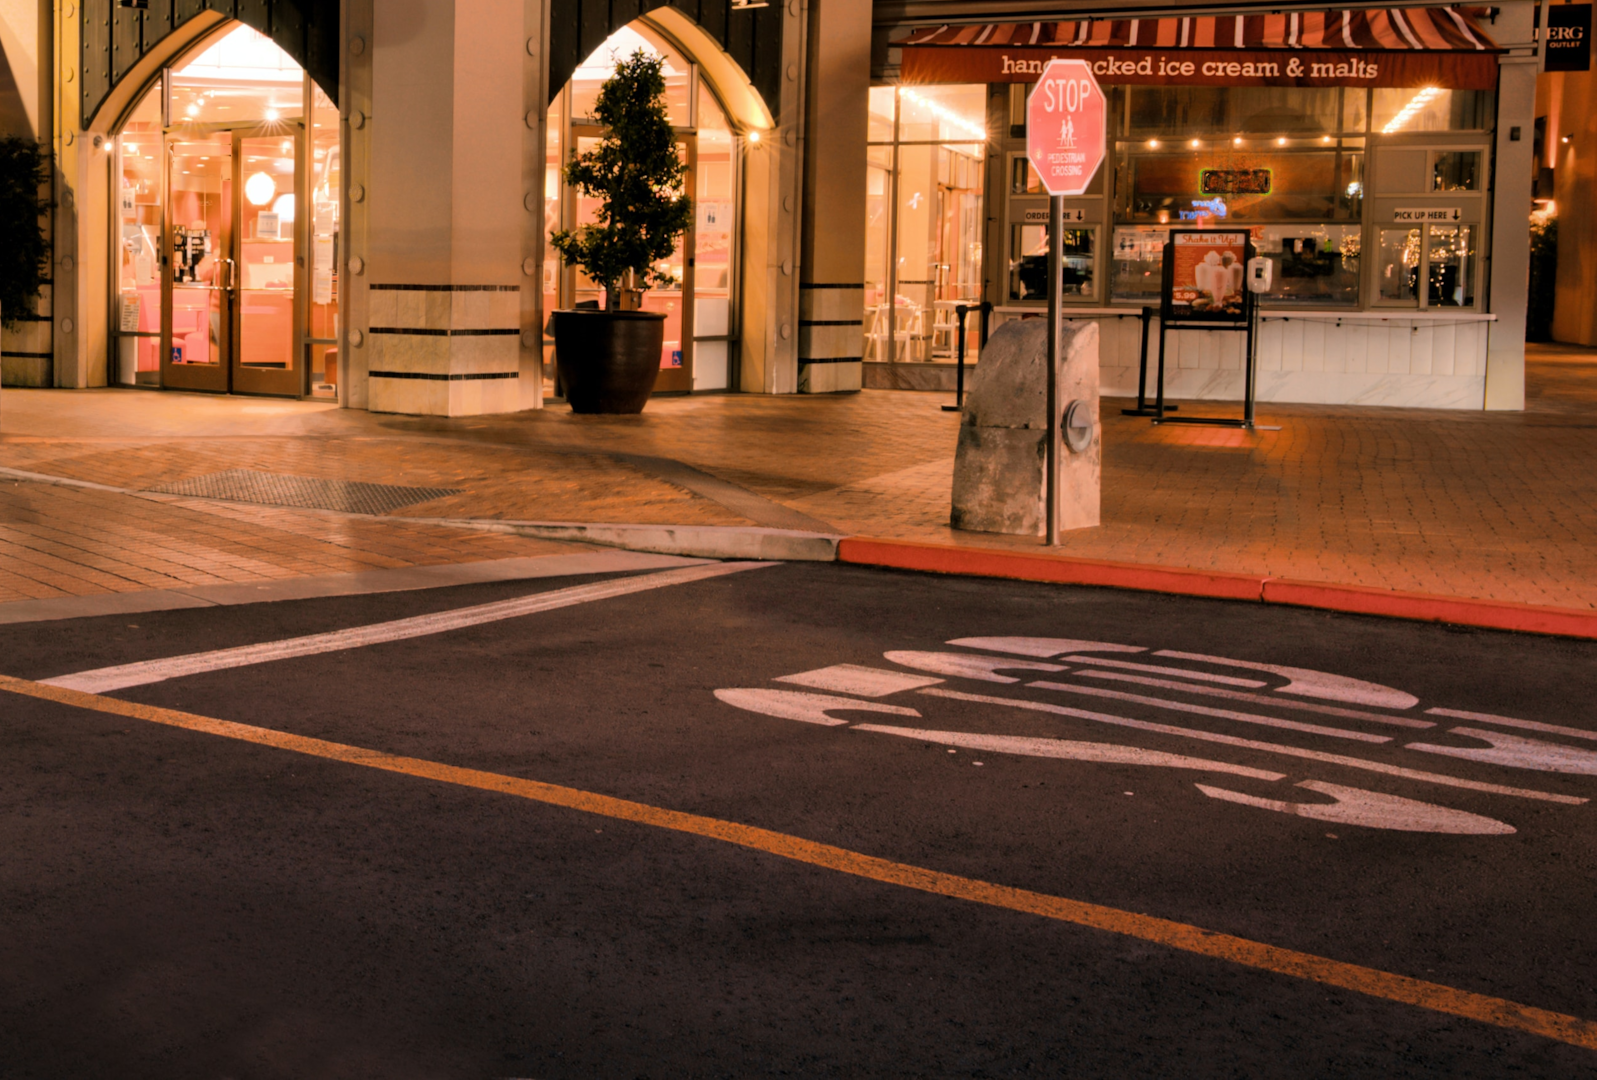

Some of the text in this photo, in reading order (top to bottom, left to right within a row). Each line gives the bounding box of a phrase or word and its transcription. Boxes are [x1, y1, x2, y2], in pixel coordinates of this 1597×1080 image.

[1158, 56, 1195, 75] ice
[1201, 60, 1280, 77] cream
[1286, 57, 1304, 77] &
[1310, 58, 1378, 79] malts
[1044, 78, 1091, 113] STOP
[1047, 152, 1086, 164] PEDESTRIAN
[1051, 165, 1082, 177] CROSSING
[1394, 211, 1448, 220] PICK UP HERE
[1182, 234, 1209, 243] Shake
[1218, 234, 1238, 247] Up!
